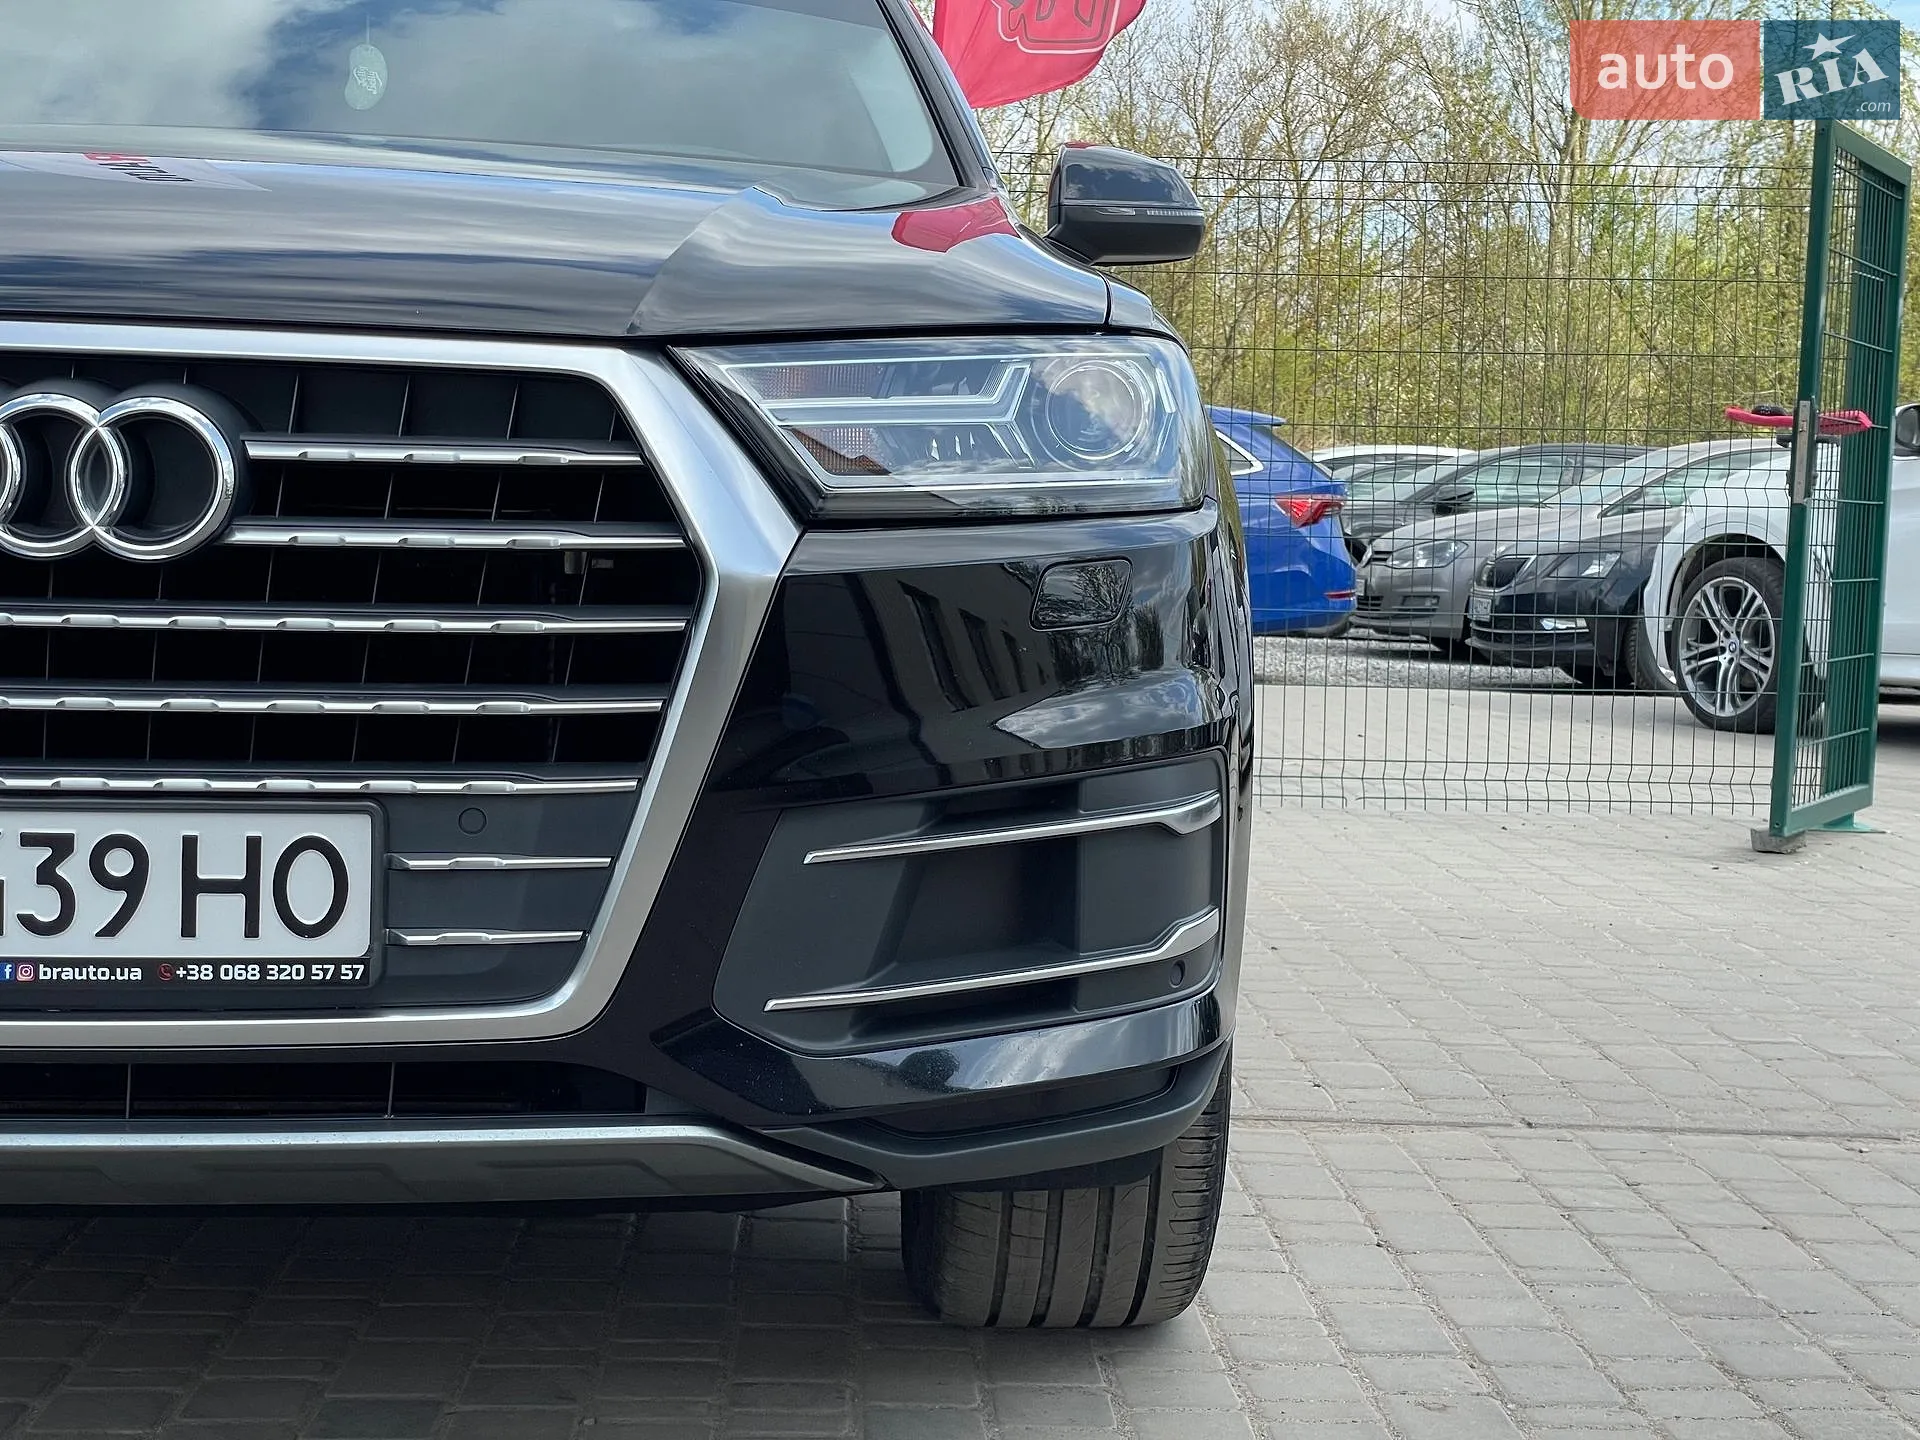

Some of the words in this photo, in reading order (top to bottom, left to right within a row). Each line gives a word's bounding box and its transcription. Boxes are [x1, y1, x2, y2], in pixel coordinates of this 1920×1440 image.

[0, 831, 150, 938] 39
[180, 834, 349, 939] HO
[38, 964, 142, 981] brauto.ua
[175, 964, 213, 981] +38
[219, 964, 260, 981] 068
[266, 964, 305, 981] 320
[311, 964, 335, 981] 57
[340, 964, 365, 981] 57
